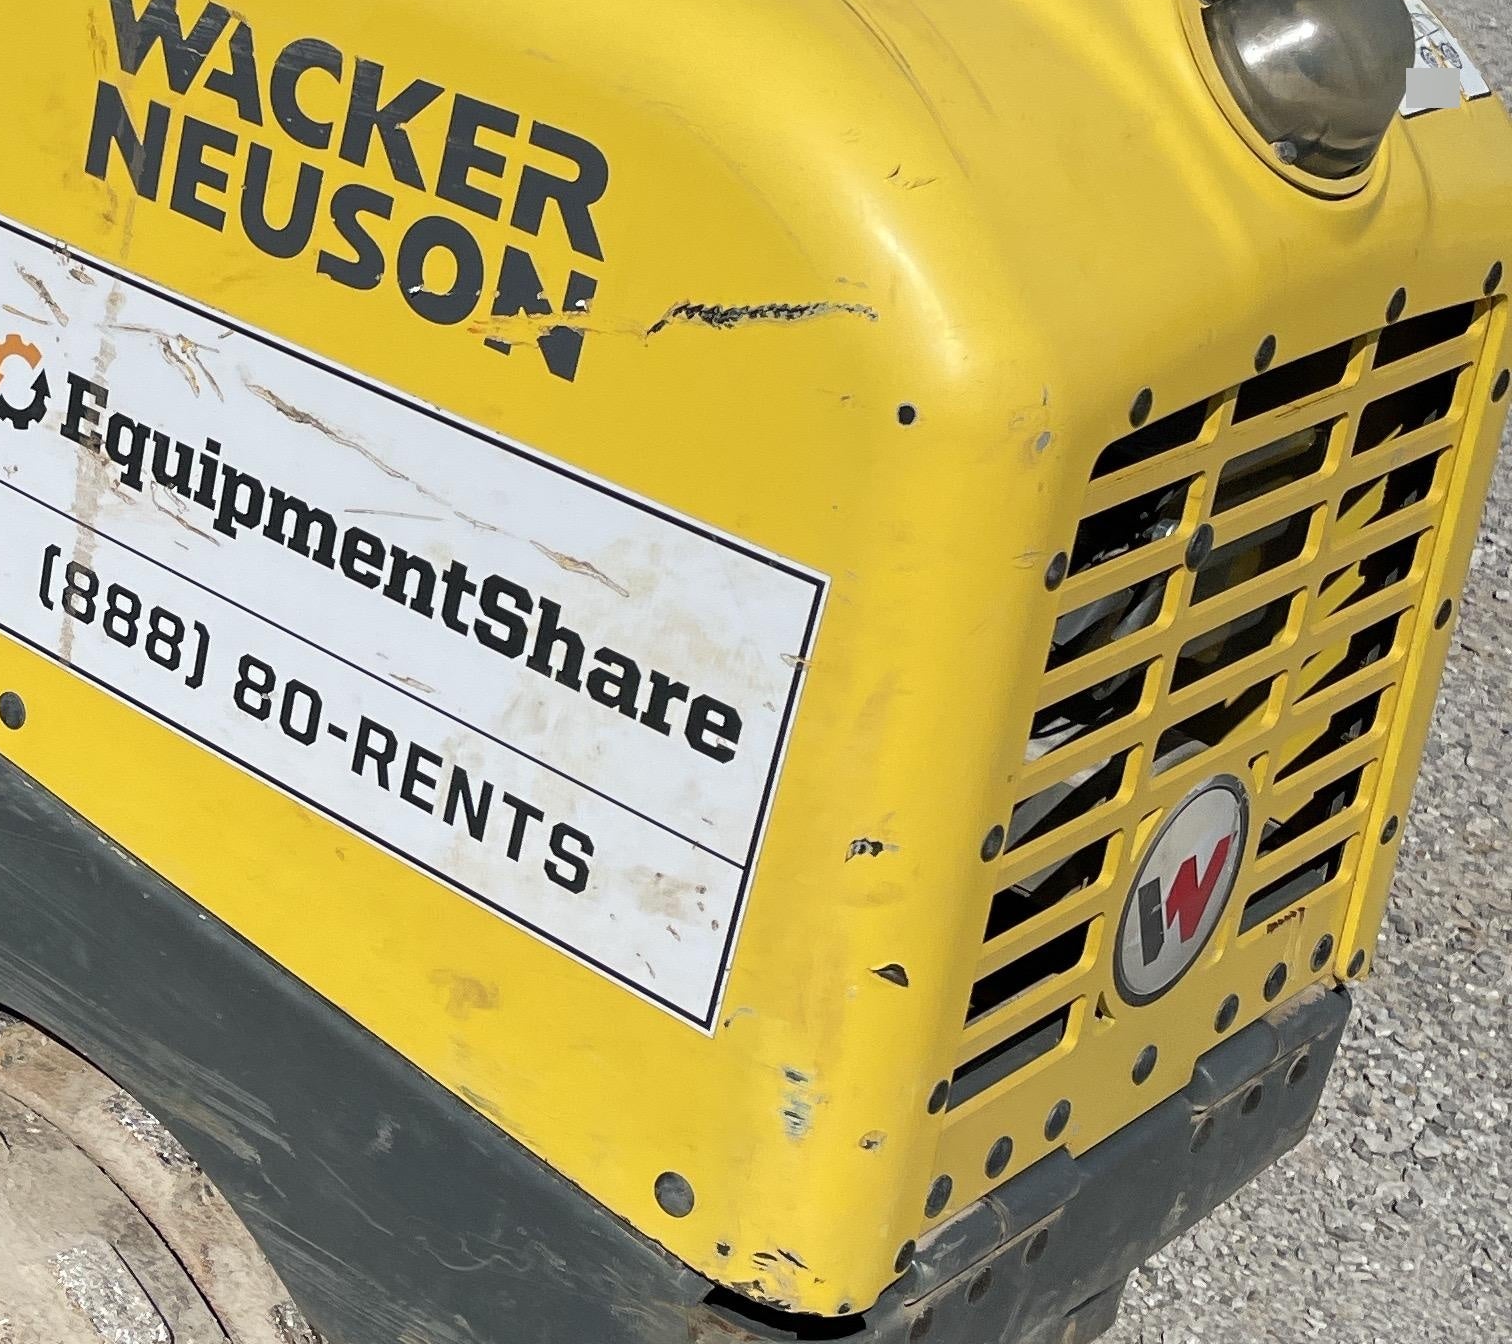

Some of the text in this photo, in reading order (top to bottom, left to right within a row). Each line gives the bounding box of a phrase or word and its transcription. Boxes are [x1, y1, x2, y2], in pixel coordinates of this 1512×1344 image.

[84, 79, 598, 383] NEUSON
[39, 543, 595, 895] (888) 80-RENTS
[60, 371, 743, 764] EquipmentShare
